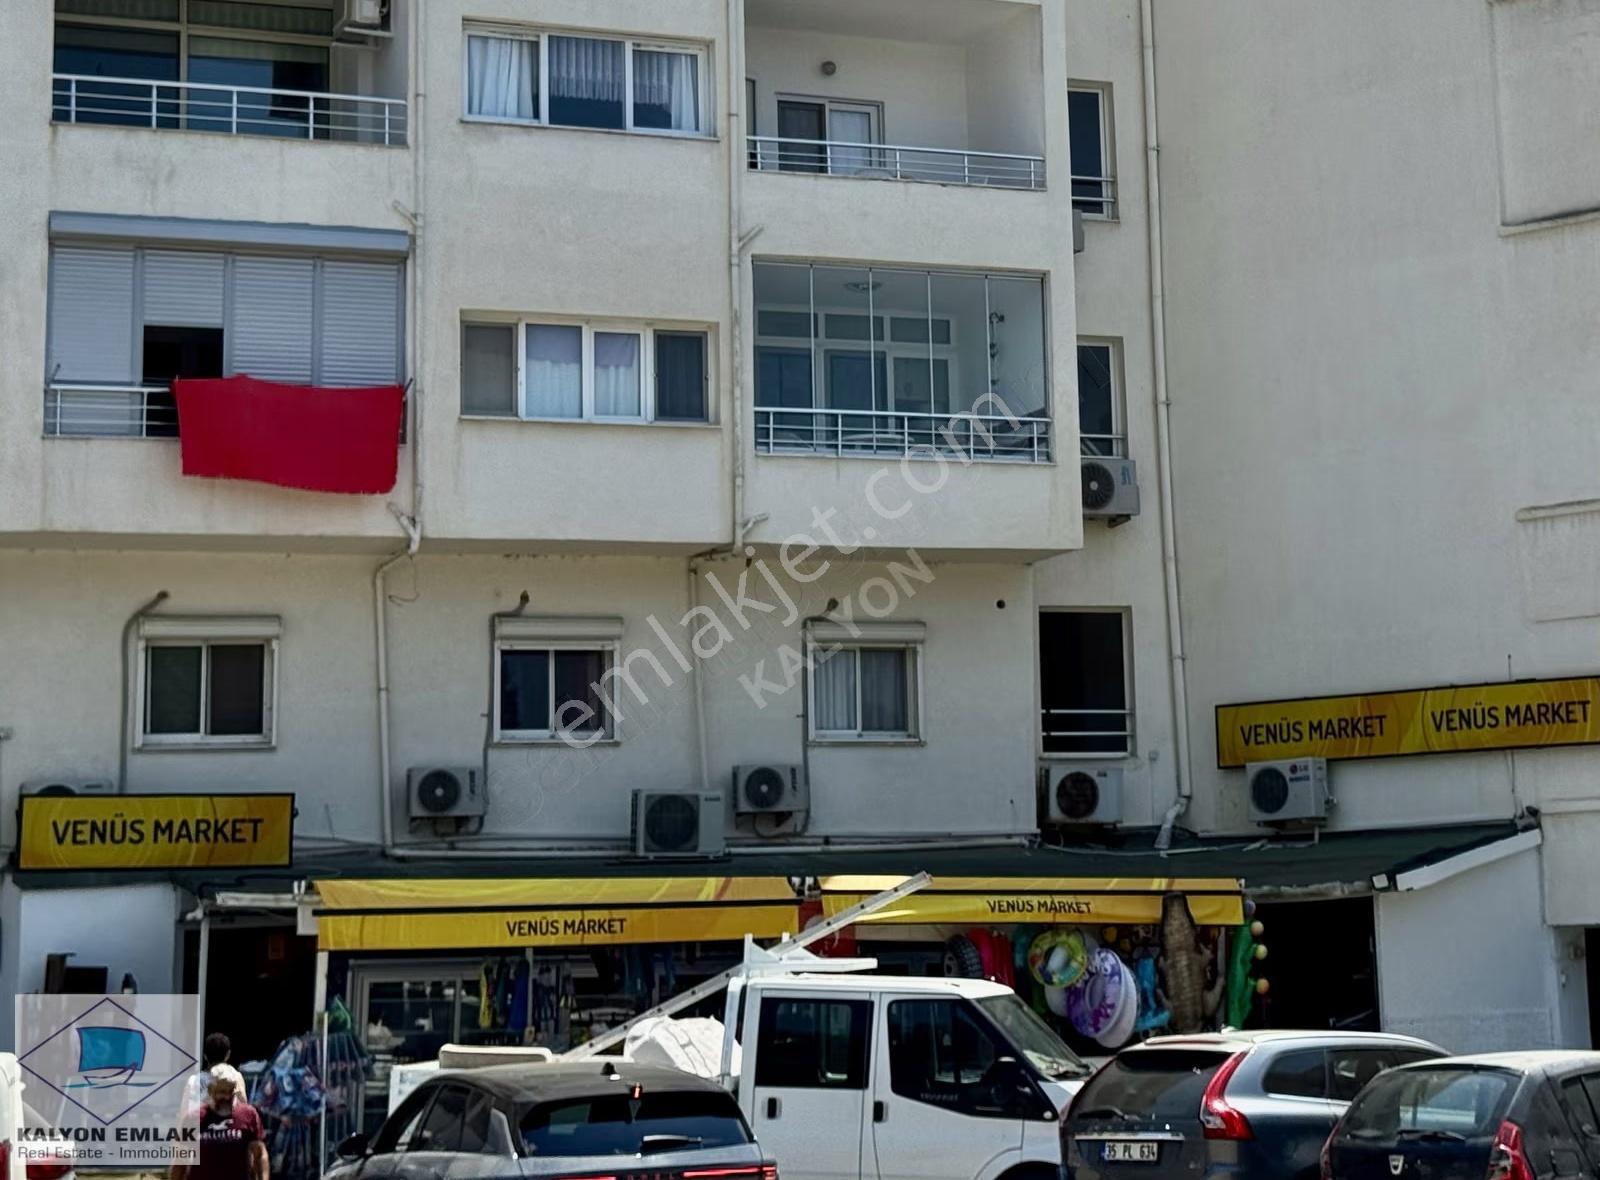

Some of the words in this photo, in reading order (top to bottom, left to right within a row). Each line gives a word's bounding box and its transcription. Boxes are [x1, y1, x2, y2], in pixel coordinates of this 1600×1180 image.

[1240, 717, 1303, 746] VENÜS
[1308, 715, 1387, 741] MARKET
[1431, 702, 1499, 732] VENÜS
[1505, 700, 1590, 727] MARKET
[52, 812, 145, 845] VENÜS
[153, 817, 264, 843] MARKET
[1037, 900, 1092, 913] MARKET
[506, 916, 560, 936] VENÜS
[563, 918, 627, 935] MARKET
